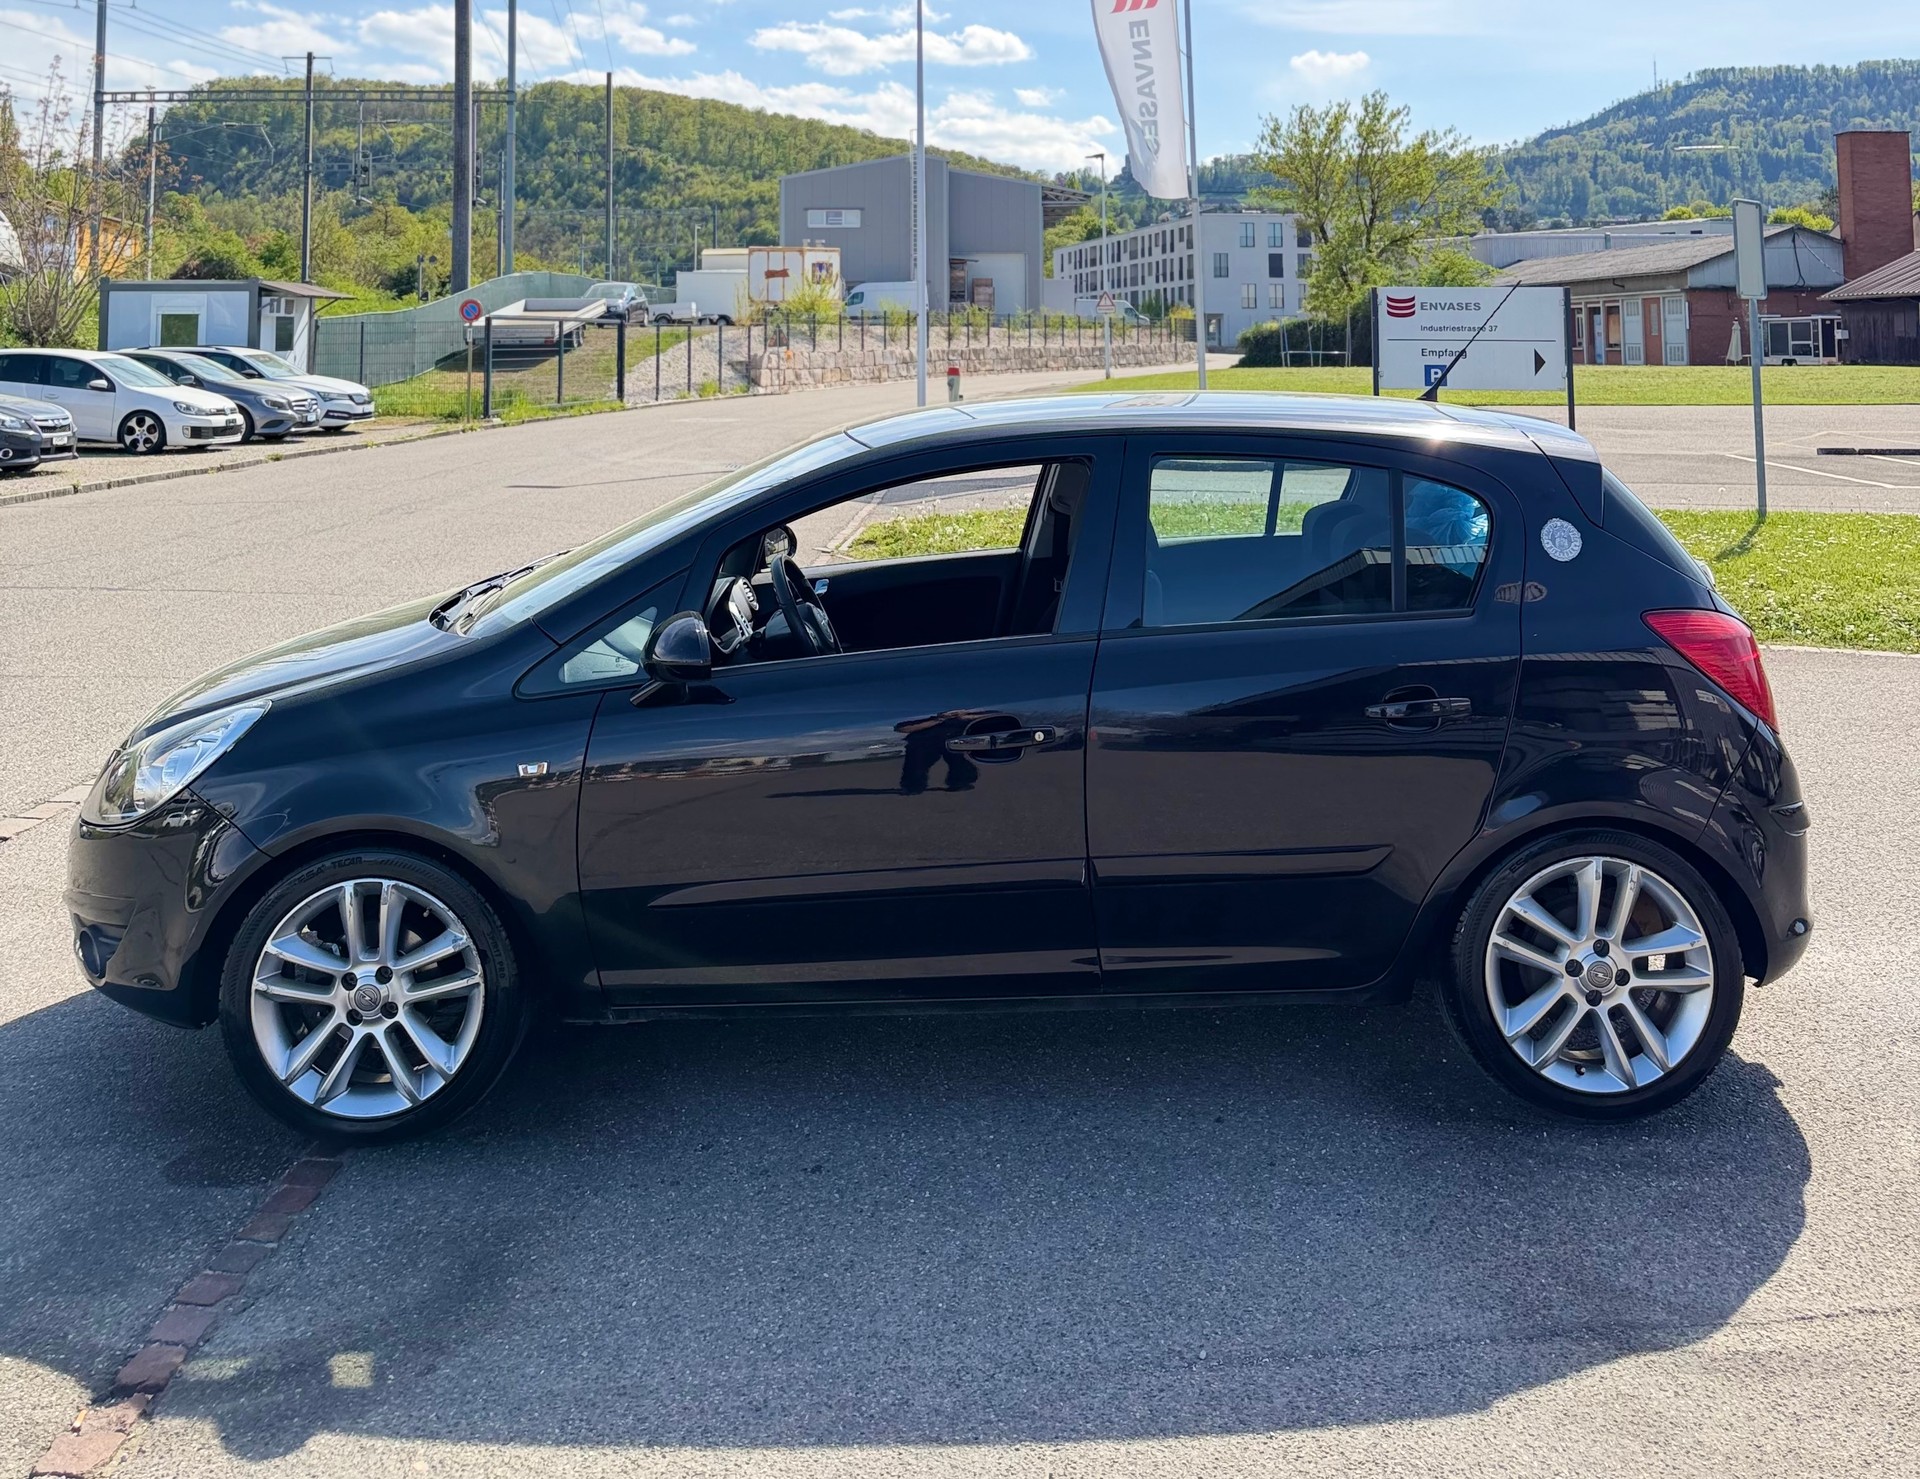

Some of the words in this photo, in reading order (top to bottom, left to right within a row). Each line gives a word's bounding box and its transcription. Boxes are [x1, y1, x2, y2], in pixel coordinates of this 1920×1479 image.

[1420, 302, 1481, 311] ENVASES
[1420, 324, 1486, 332] Industriestrasse
[1430, 368, 1443, 383] P
